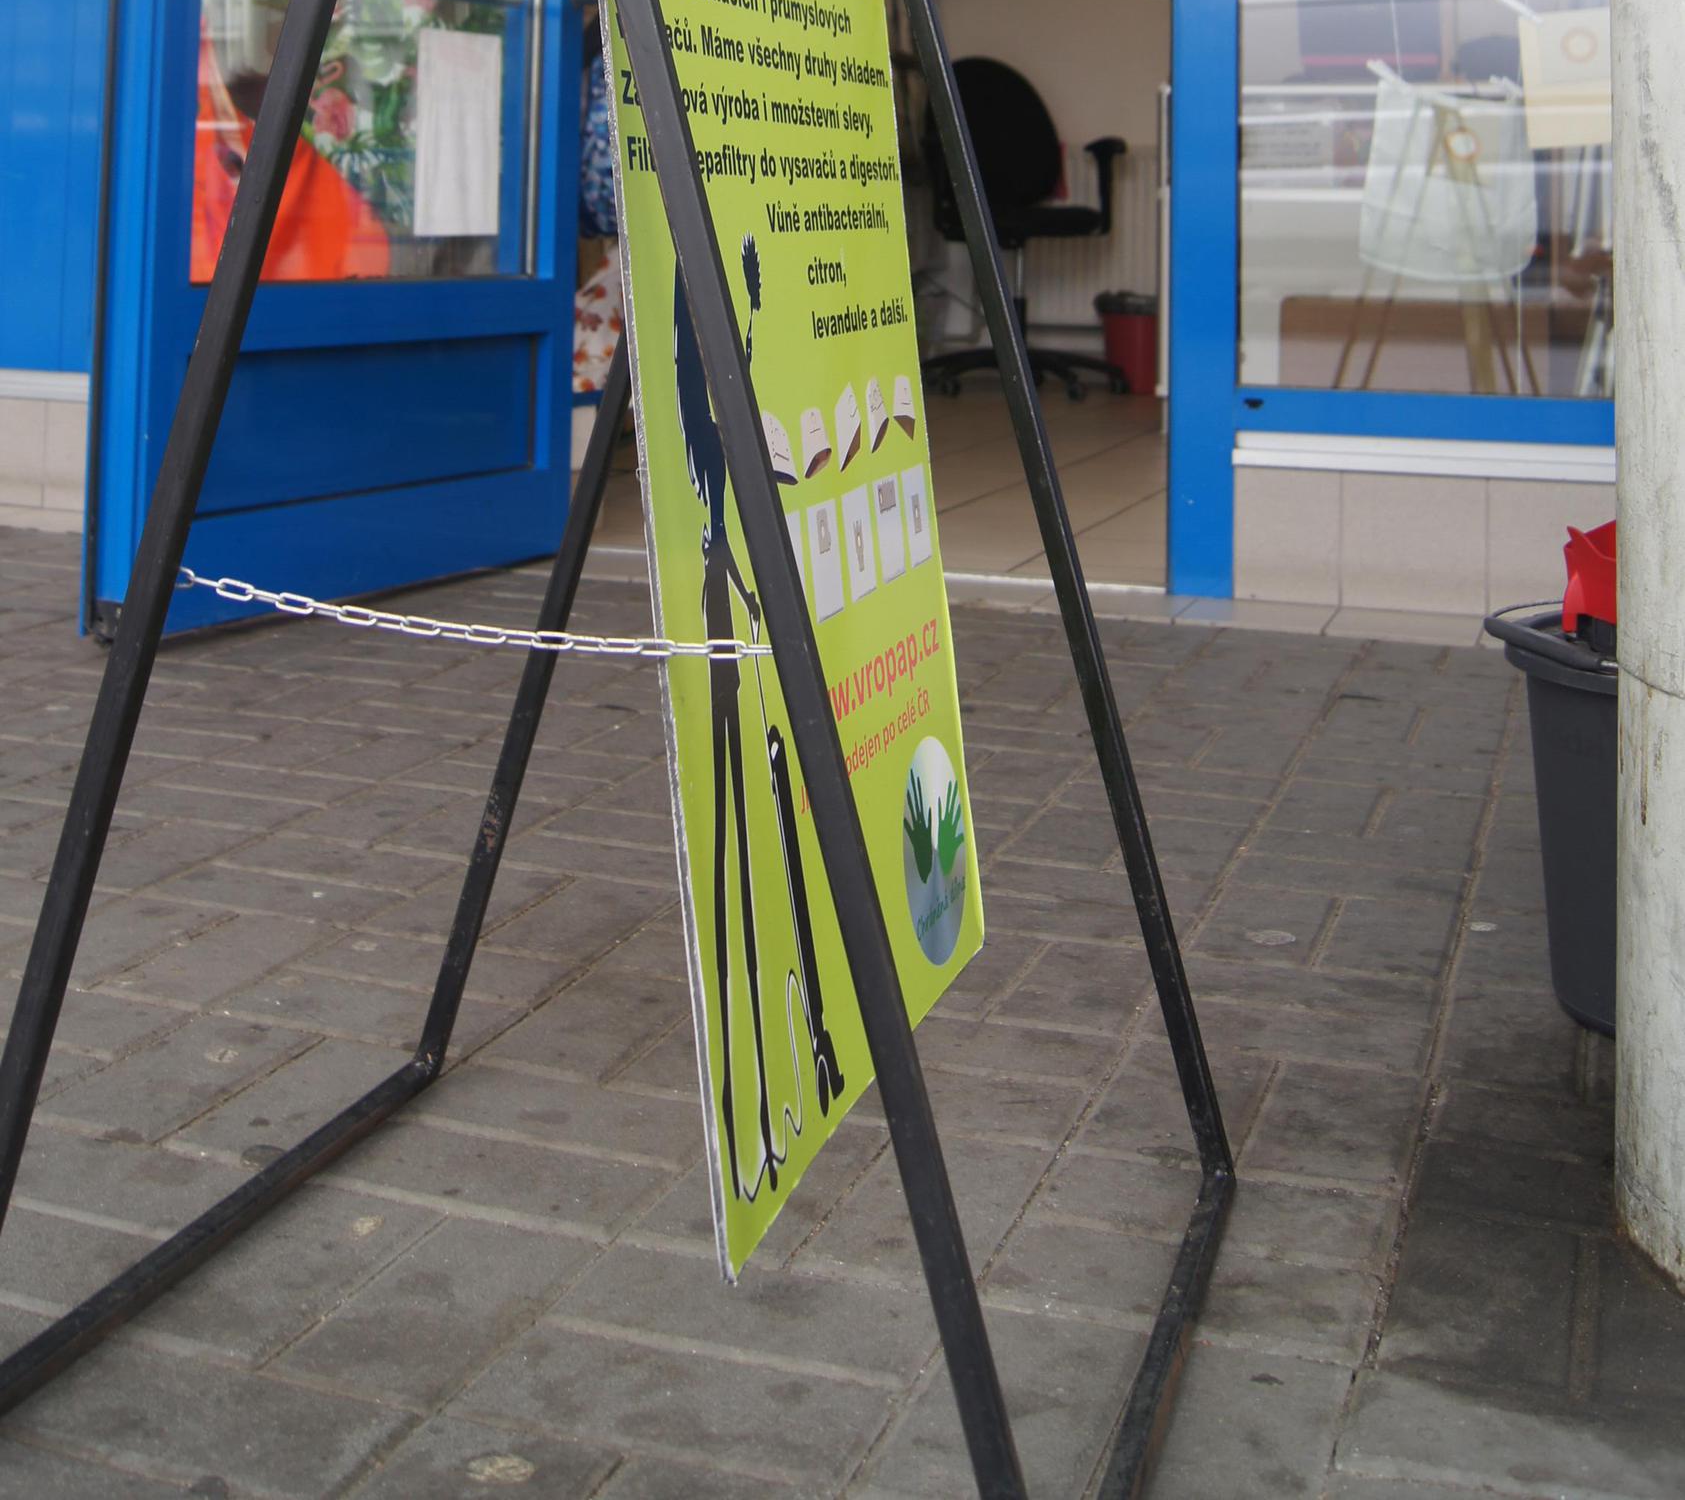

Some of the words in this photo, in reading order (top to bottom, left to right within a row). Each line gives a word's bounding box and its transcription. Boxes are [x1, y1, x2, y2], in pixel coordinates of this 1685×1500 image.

[700, 24, 745, 63] Máme
[748, 36, 801, 80] všechny
[805, 48, 838, 86] druhy
[840, 61, 889, 88] skladem.
[711, 85, 760, 125] výroba
[762, 92, 767, 120] i
[771, 95, 841, 129] množstevní
[843, 108, 873, 139] slevy.
[696, 144, 756, 184] epafiltry
[760, 152, 777, 178] do
[780, 149, 837, 185] vysavačů
[840, 161, 847, 178] a
[850, 153, 899, 187] digestoří.
[766, 201, 801, 233] Vůně
[804, 202, 889, 234] antibacteriální,
[807, 256, 847, 288] citron,
[812, 304, 868, 340] levandule
[871, 310, 878, 328] a
[881, 297, 908, 325] další.
[827, 618, 940, 722] w.vropap.cz
[845, 735, 880, 778] odejen
[882, 721, 895, 754] po
[897, 697, 916, 734] celé
[917, 686, 931, 717] ČR
